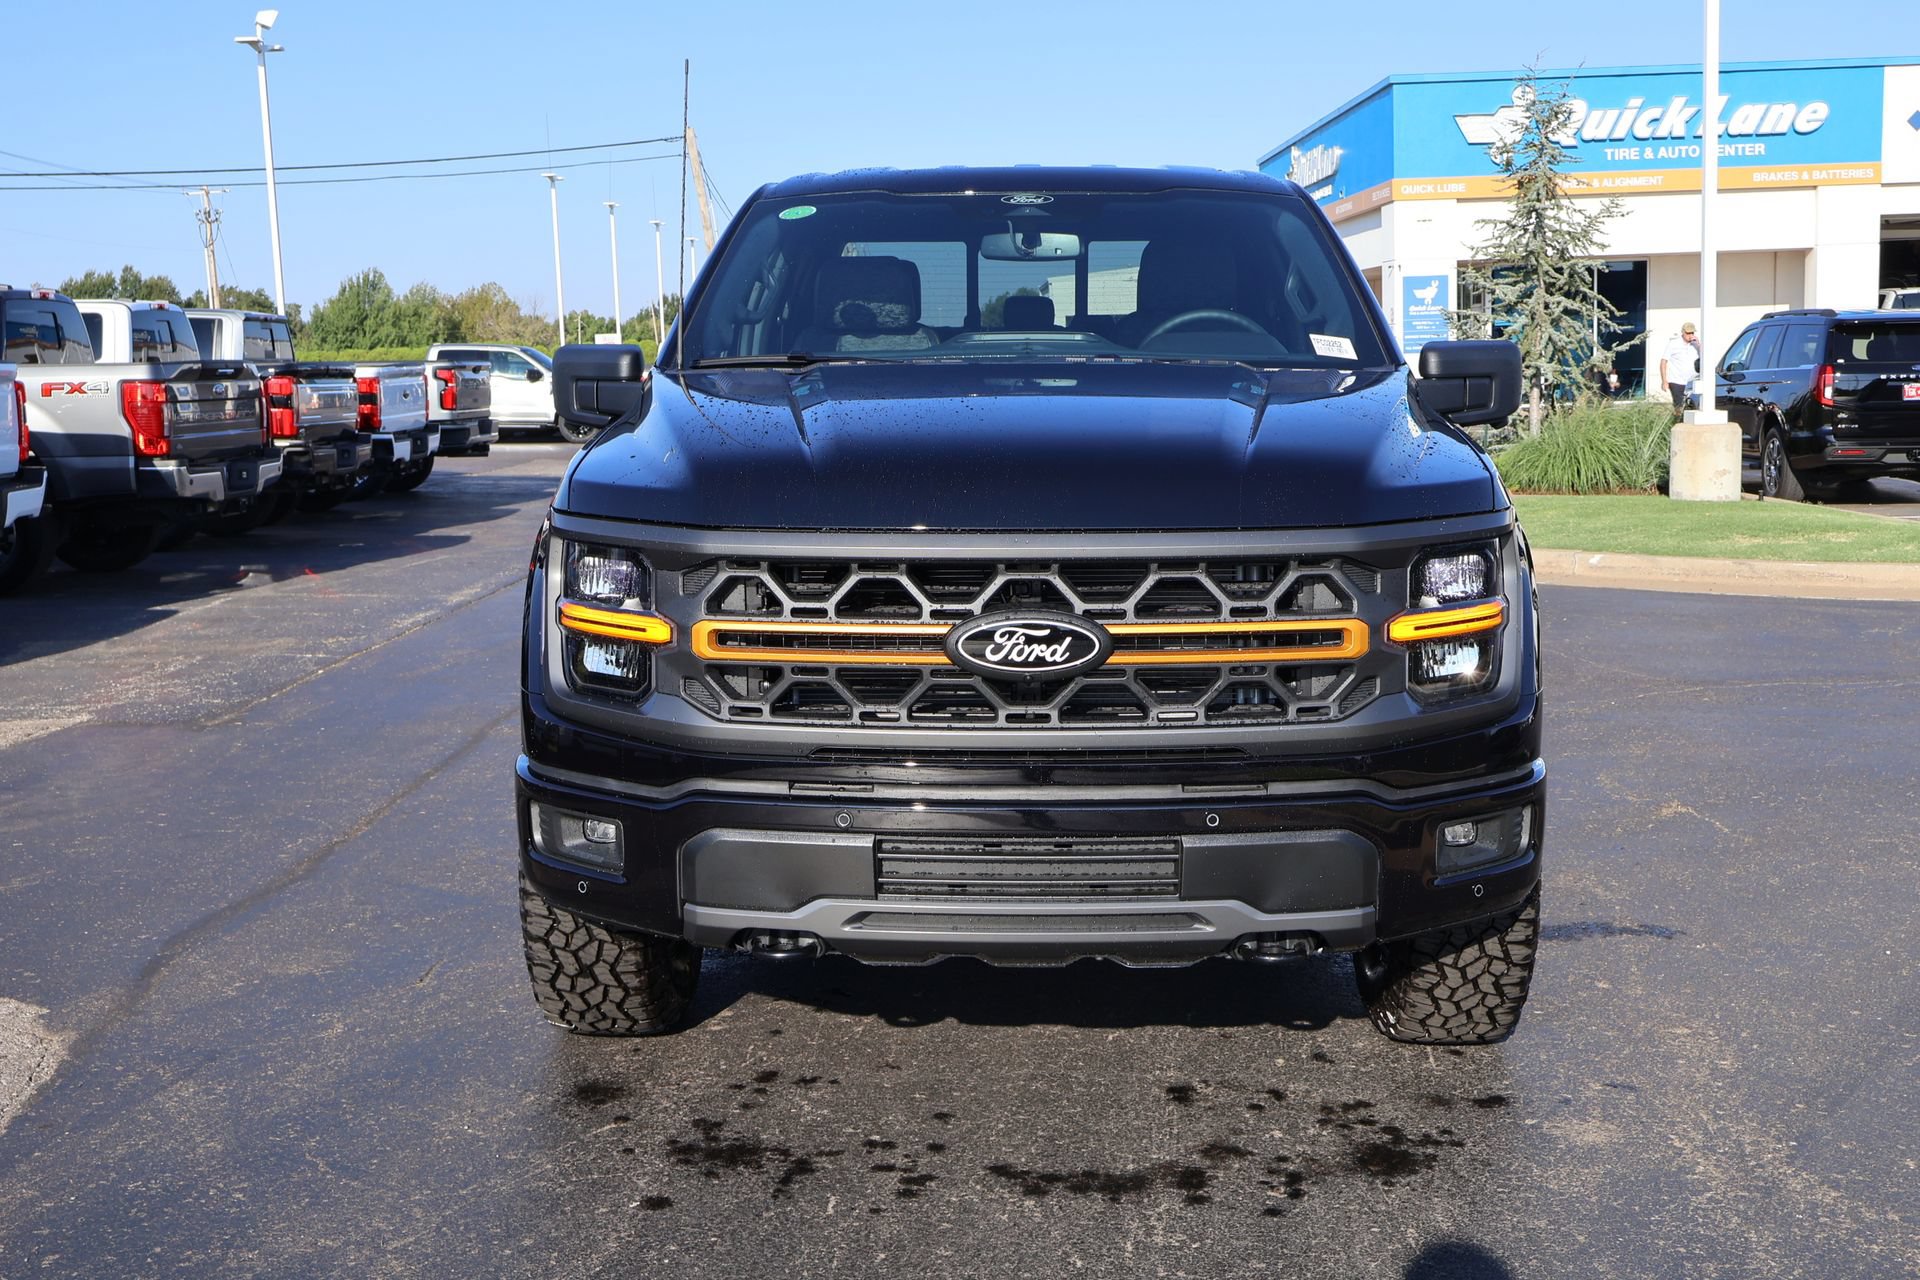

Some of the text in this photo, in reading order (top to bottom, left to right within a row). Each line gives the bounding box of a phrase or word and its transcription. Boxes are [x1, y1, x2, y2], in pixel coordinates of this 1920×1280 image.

[1605, 143, 1765, 161] TIRE & AUTO ENTER
[1602, 175, 1664, 188] ALIGNMENT
[1753, 168, 1873, 182] BRAKES & BATTERIES
[1401, 183, 1466, 194] QUICK LUBE
[41, 381, 109, 397] FX4
[985, 627, 1072, 662] Ford
